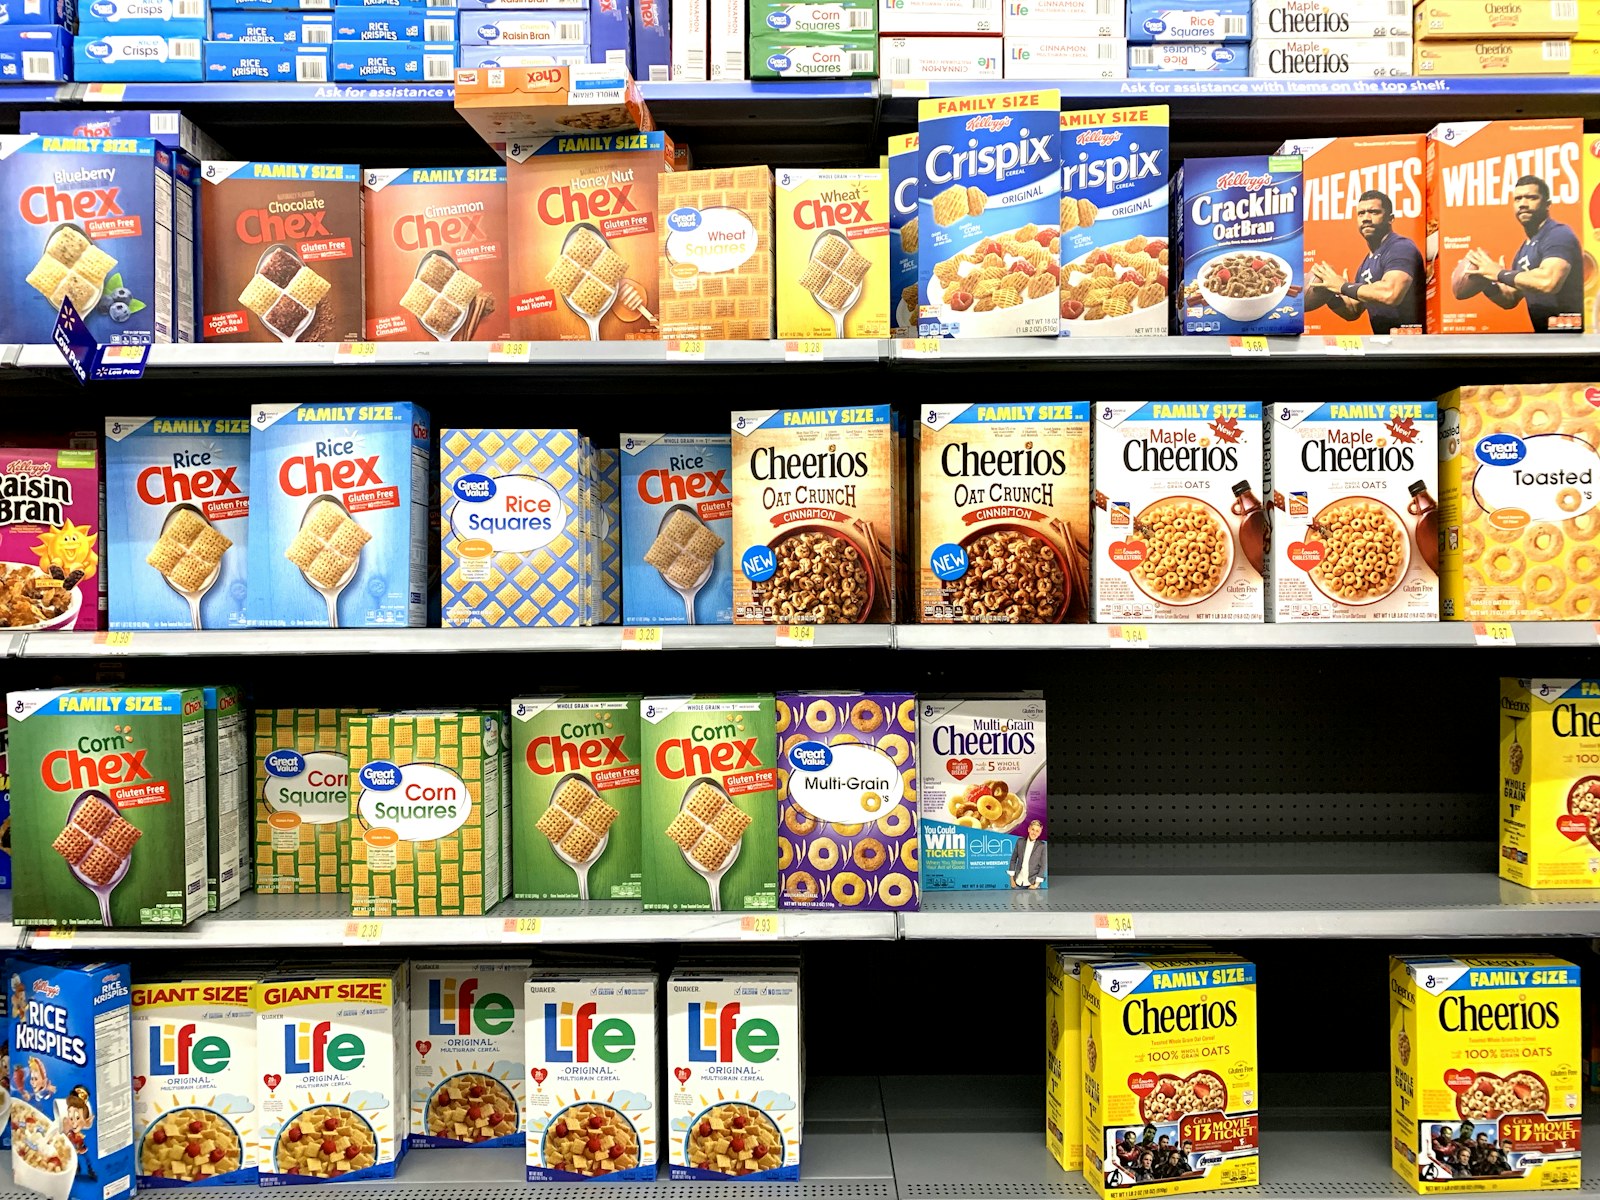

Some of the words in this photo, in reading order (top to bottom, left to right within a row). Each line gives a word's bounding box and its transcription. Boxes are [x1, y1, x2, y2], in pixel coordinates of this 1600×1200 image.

[127, 4, 163, 15] Crisps
[1190, 16, 1215, 26] Rice
[502, 31, 529, 40] Raisin
[530, 31, 550, 40] Bran
[1170, 27, 1215, 38] Squares
[1287, 42, 1319, 53] Maple
[240, 58, 260, 67] RICE
[812, 52, 841, 63] Corn
[1268, 49, 1349, 74] Cheerios
[232, 66, 269, 77] KRISPIES
[359, 65, 397, 76] KRISPIES
[795, 63, 841, 75] Squares
[315, 86, 340, 97] Ask
[347, 86, 366, 98] for
[370, 87, 439, 97] assistance
[1120, 83, 1146, 93] Ask
[1150, 82, 1171, 93] for
[1174, 82, 1249, 94] assistance
[1251, 82, 1286, 92] with
[1287, 82, 1329, 92] items
[1331, 83, 1351, 92] on
[1353, 81, 1377, 92] the
[1380, 81, 1408, 94] top
[1411, 80, 1450, 91] shelf.
[937, 97, 998, 114] FAMILY
[1002, 94, 1040, 109] SIZE
[965, 114, 1014, 132] Kellogg's
[1060, 112, 1106, 127] AMILY
[1111, 110, 1149, 123] SIZE
[558, 136, 610, 152] FAMILY
[615, 135, 648, 149] SIZE
[925, 127, 1053, 184] Crispix
[54, 167, 116, 184] Blueberry
[571, 173, 610, 190] Honey
[610, 168, 635, 181] Nut
[1005, 168, 1025, 177] CEREAL
[1217, 171, 1273, 191] Kellogg's
[1442, 142, 1580, 208] WHEATIES
[820, 187, 861, 204] Wheat
[1001, 185, 1044, 206] ORIGINAL
[19, 185, 124, 225] Chex
[268, 198, 325, 214] Chocolate
[425, 200, 484, 218] Cinnamon
[537, 184, 637, 226] Chex
[1191, 186, 1298, 226] Cracklin'
[793, 199, 874, 230] Chex
[236, 208, 330, 245] Chex
[392, 213, 488, 251] Chex
[1212, 223, 1241, 241] Oat
[1241, 219, 1275, 236] Bran
[707, 230, 746, 242] Wheat
[685, 242, 746, 258] Squares
[216, 325, 238, 334] Cocoa
[684, 341, 700, 353] 2.38
[804, 342, 820, 353] 3.28
[108, 368, 122, 376] Low
[123, 368, 141, 376] Price
[1150, 428, 1197, 449] Maple
[1216, 423, 1236, 438] New!
[1328, 428, 1374, 449] Maple
[315, 438, 354, 458] Rice
[1123, 438, 1239, 472] Cheerios
[1301, 438, 1415, 473] Cheerios
[1480, 441, 1518, 453] Great
[1489, 450, 1519, 460] Value
[173, 449, 212, 469] Rice
[669, 453, 704, 472] Rice
[750, 446, 868, 481] Cheerios
[941, 441, 1067, 478] Cheerios
[279, 455, 384, 497] Chex
[1513, 468, 1592, 486] Toasted
[136, 466, 243, 506] Chex
[457, 479, 489, 491] Great
[465, 488, 490, 497] Value
[637, 469, 730, 505] Chex
[348, 491, 375, 503] Gluten
[376, 489, 394, 499] Free
[505, 495, 551, 513] Rice
[763, 486, 792, 510] OAT
[795, 484, 857, 508] CRUNCH
[0, 500, 62, 525] Bran
[783, 508, 837, 523] CINNAMON
[468, 513, 552, 534] Squares
[933, 549, 965, 575] NEW
[793, 627, 810, 639] 3.64
[59, 696, 123, 712] FAMILY
[125, 696, 163, 711] SIZE
[560, 721, 605, 740] Corn
[691, 723, 736, 743] Corn
[973, 719, 999, 731] Multi
[1006, 718, 1035, 731] Grain
[77, 733, 125, 754] Corn
[932, 724, 1036, 756] Cheerios
[269, 756, 298, 767] Great
[525, 735, 630, 776] Chex
[655, 737, 762, 780] Chex
[793, 747, 826, 760] Great
[801, 757, 826, 767] Value
[40, 749, 153, 793] Chex
[276, 765, 299, 773] Value
[363, 768, 395, 780] Great
[987, 761, 995, 772] 5
[371, 776, 396, 786] Value
[804, 776, 889, 791] Multi-Grain
[405, 783, 456, 801] Corn
[374, 802, 457, 823] Squares
[924, 824, 937, 834] You
[937, 825, 956, 835] Could
[924, 832, 966, 849] win
[970, 837, 1013, 855] ellen
[925, 849, 966, 858] TICKETS
[361, 924, 378, 938] 2.38
[519, 918, 536, 932] 3.28
[755, 918, 771, 932] 2.93
[1115, 918, 1132, 931] 3.64
[264, 985, 334, 1005] GIANT
[673, 985, 700, 993] QUAKER
[428, 978, 515, 1036] Life
[1438, 995, 1559, 1032] Cheerios
[29, 1000, 67, 1034] RICE
[1122, 998, 1238, 1036] Cheerios
[544, 1001, 637, 1064] Life
[688, 1001, 780, 1064] Life
[15, 1023, 87, 1065] KRISPIES
[149, 1023, 231, 1076] Life
[284, 1021, 366, 1074] Life
[1201, 1045, 1230, 1057] OATS
[1147, 1050, 1179, 1062] 100%
[564, 1066, 613, 1075] ORIGINAL
[708, 1066, 757, 1075] ORIGINAL
[1395, 1065, 1414, 1086] WHOLE
[1395, 1076, 1414, 1098] GRAIN
[1183, 1122, 1212, 1141] $13
[1212, 1119, 1251, 1132] MOVIE
[1212, 1127, 1256, 1140] TICKET
[1534, 1121, 1574, 1133] MOVIE
[1534, 1130, 1577, 1141] TICKET
